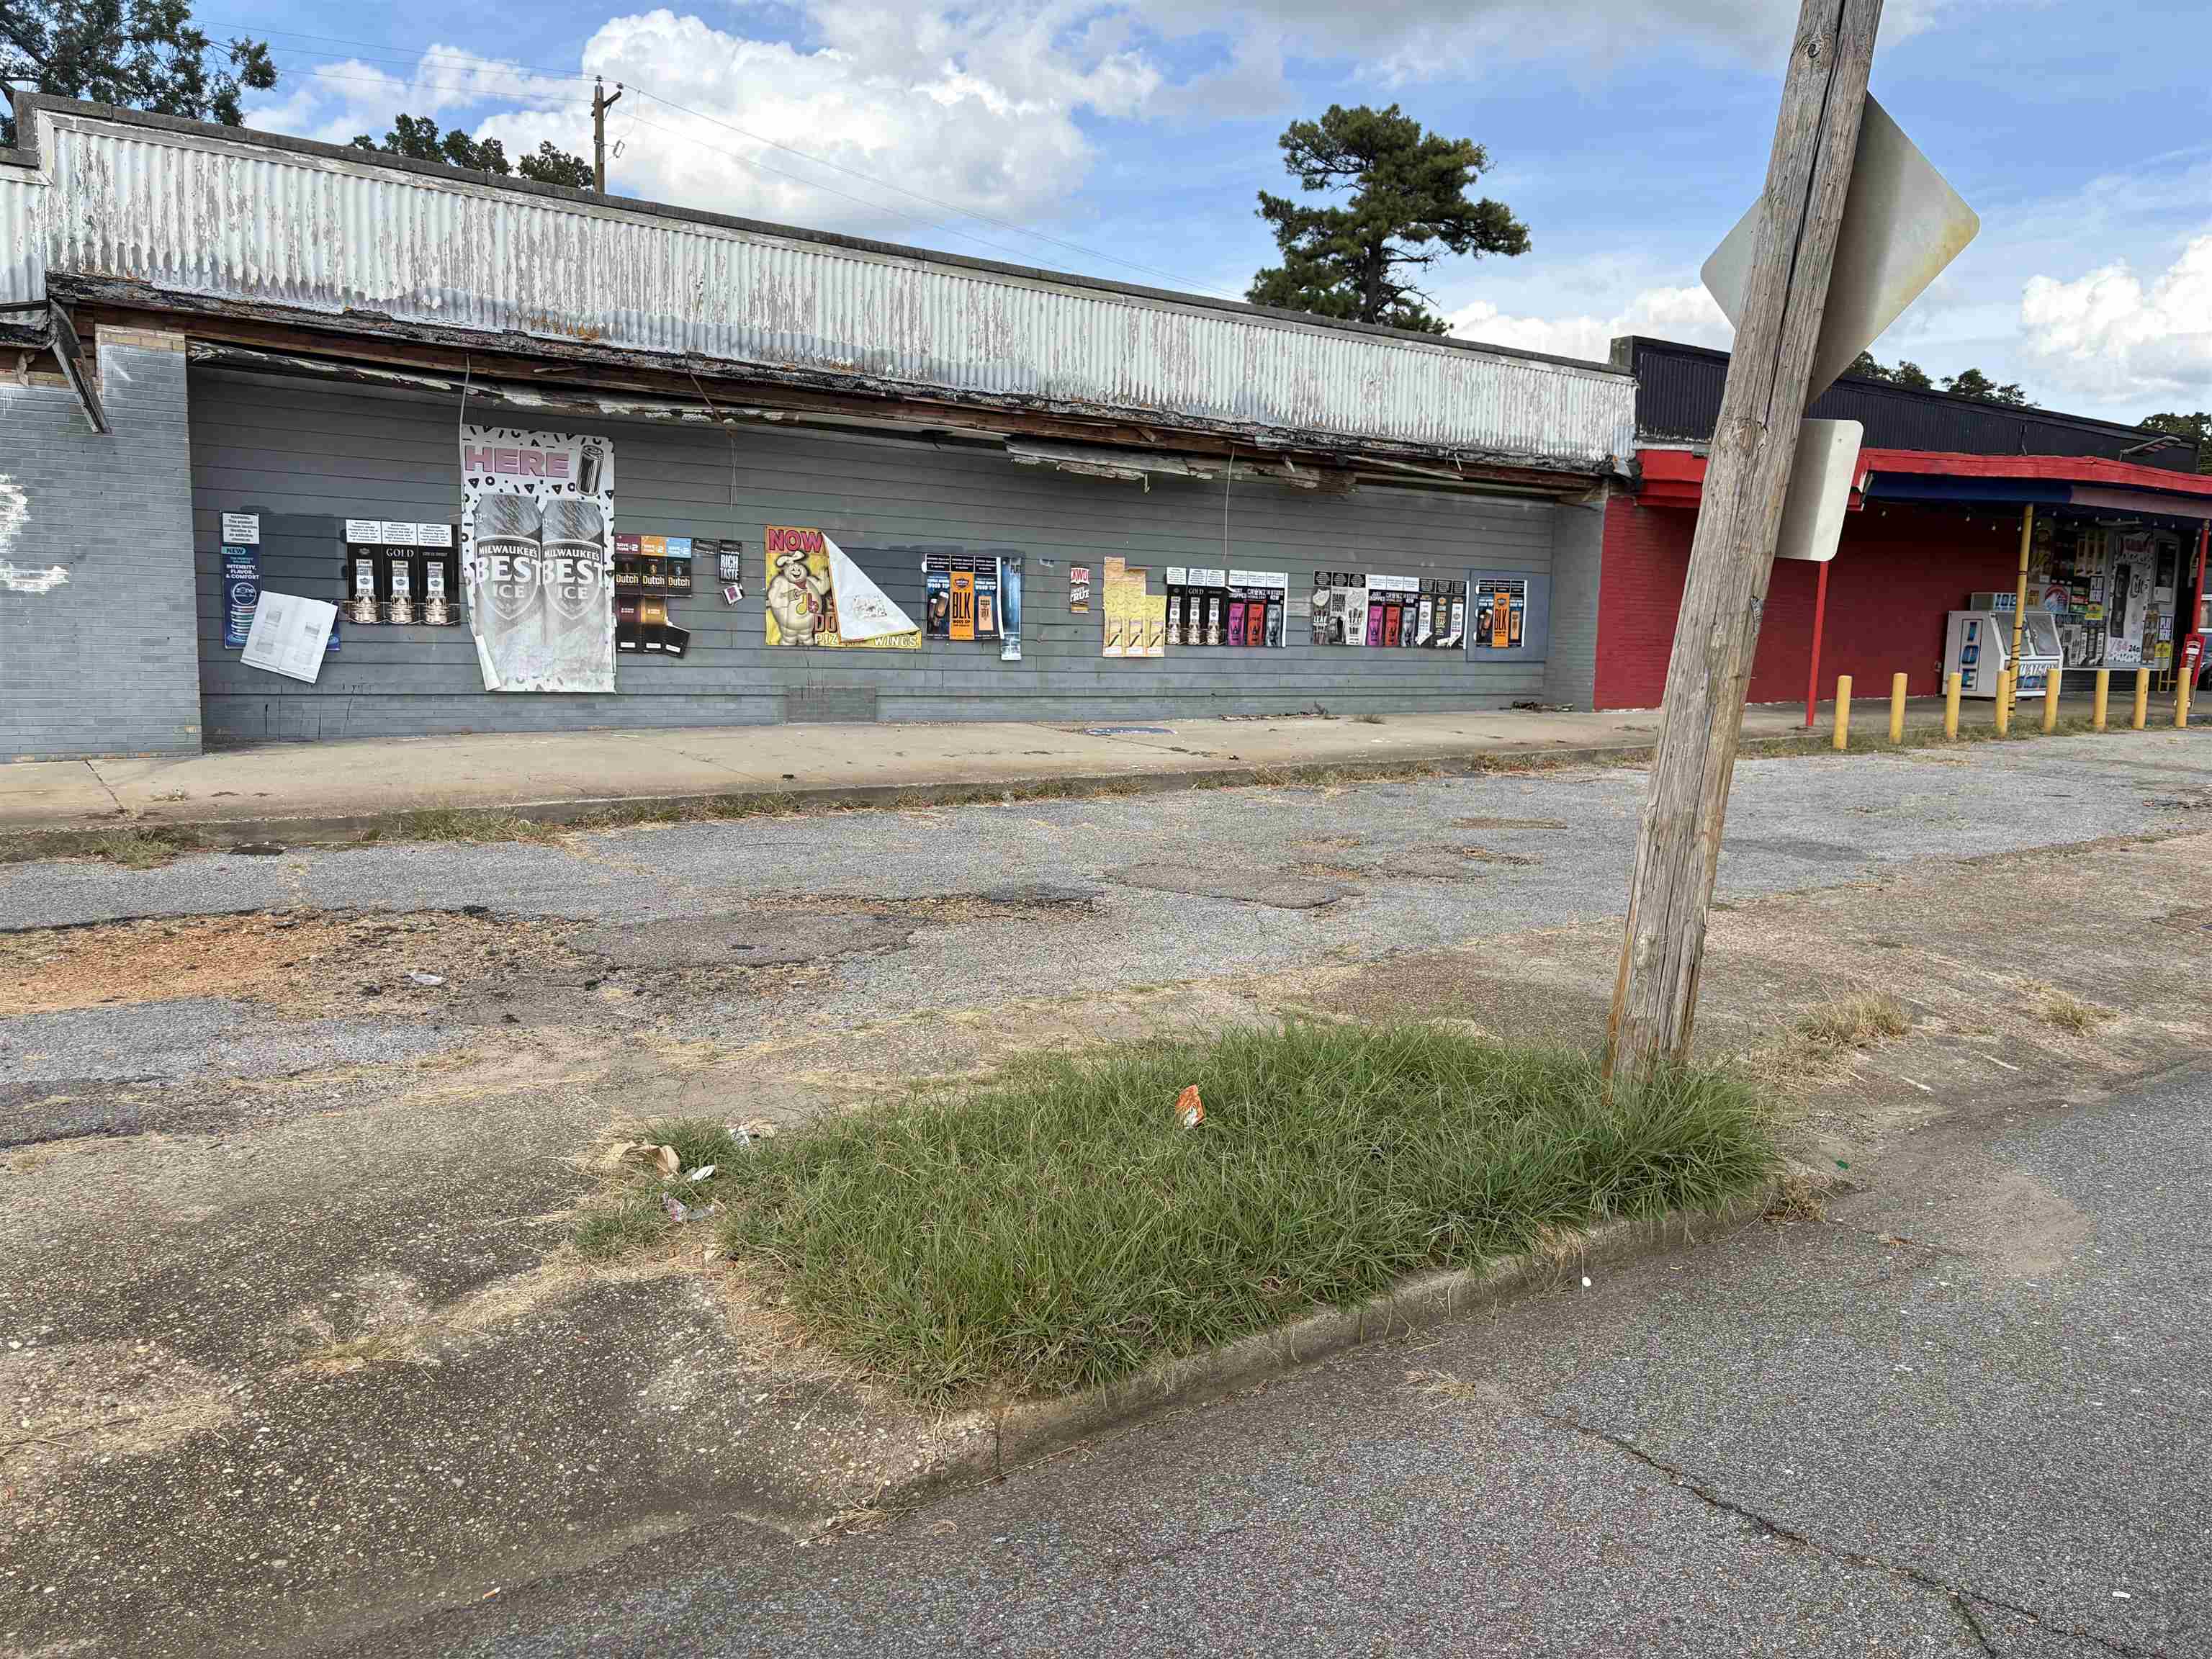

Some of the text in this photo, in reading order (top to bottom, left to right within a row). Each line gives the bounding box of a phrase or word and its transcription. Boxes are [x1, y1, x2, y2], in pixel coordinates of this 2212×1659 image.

[465, 445, 570, 478] HERE
[768, 529, 823, 553] NOW
[386, 548, 414, 557] GOLD
[479, 545, 538, 558] MILWAUKEE'S
[544, 549, 600, 561] MILWAUKEE'S
[720, 554, 739, 568] RICH
[476, 556, 541, 585] BEST
[543, 559, 604, 588] BEST
[720, 567, 739, 580] TASTE
[616, 575, 639, 584] Dutch
[642, 576, 665, 585] Dutch
[667, 577, 691, 586] Dutch
[493, 585, 526, 598] ICE
[558, 587, 589, 600] ICE
[952, 591, 971, 619] BLK
[874, 634, 917, 647] WINGS
